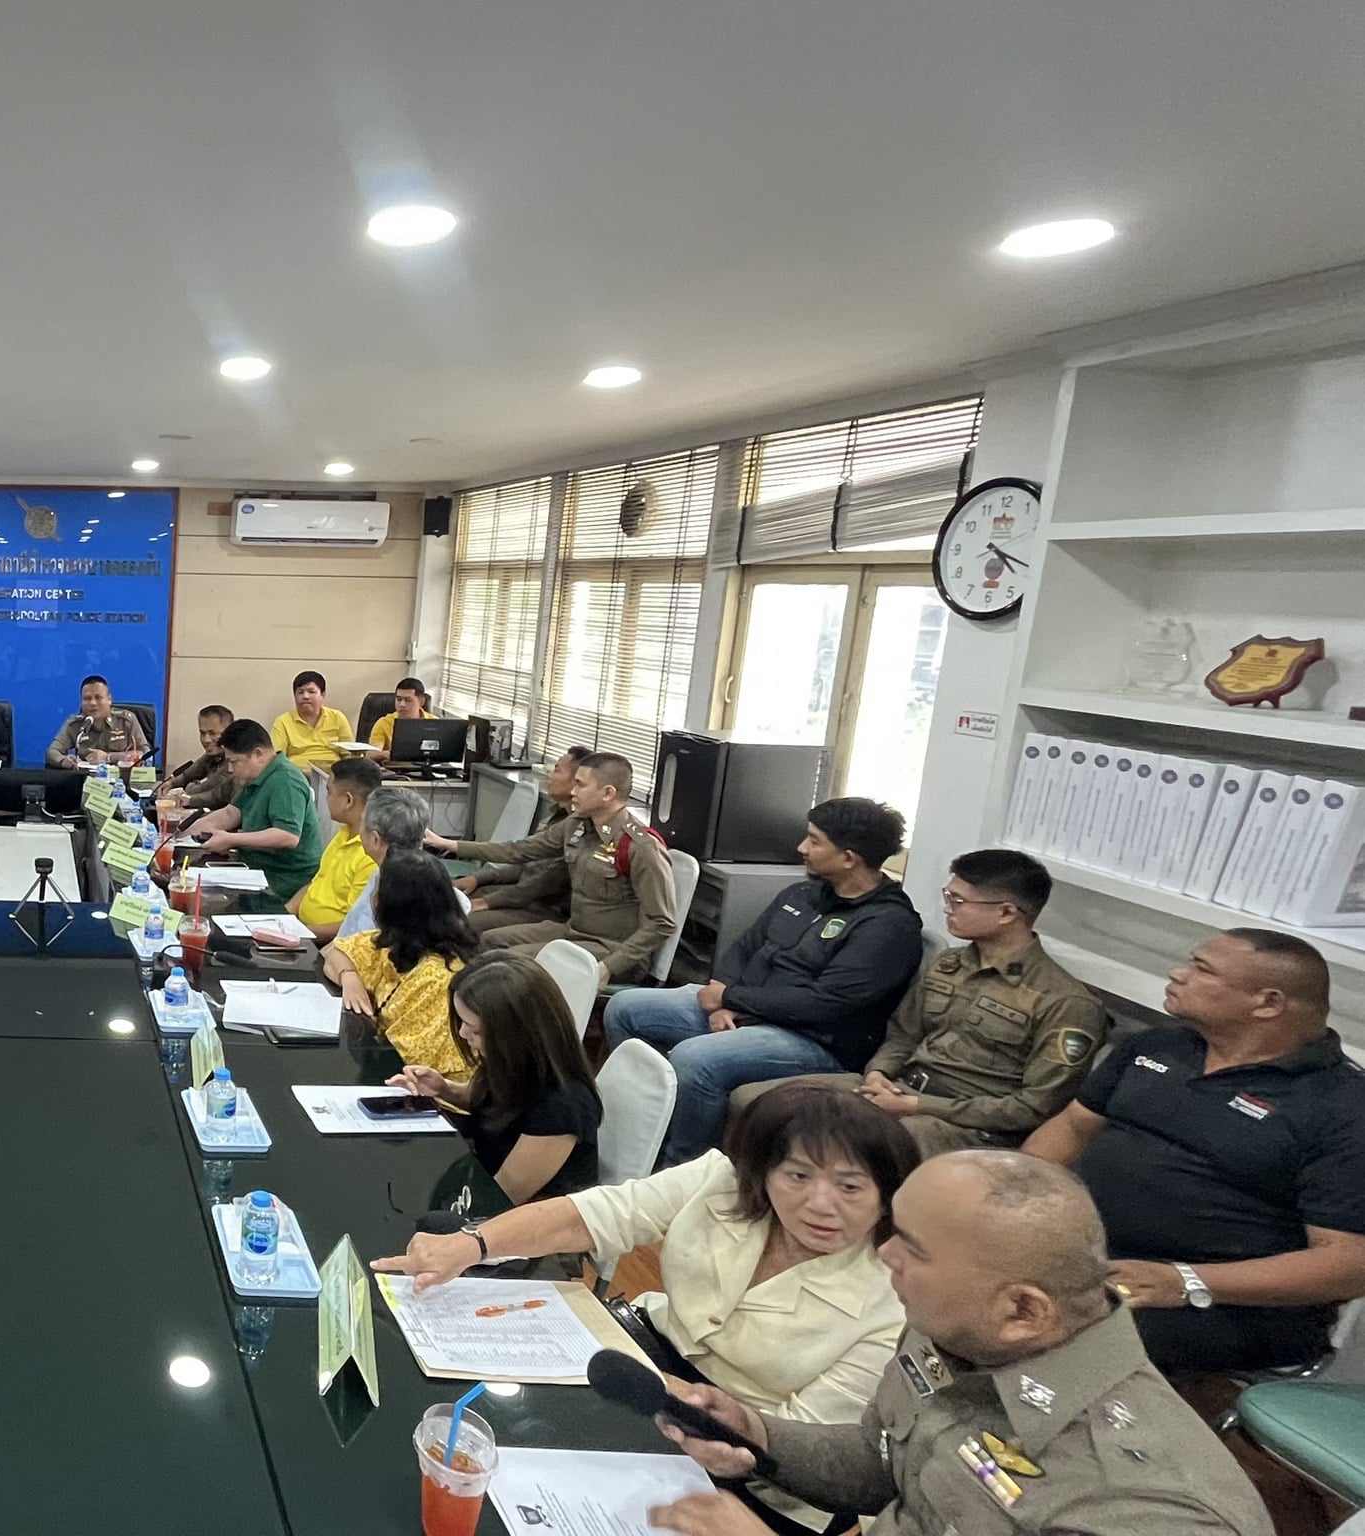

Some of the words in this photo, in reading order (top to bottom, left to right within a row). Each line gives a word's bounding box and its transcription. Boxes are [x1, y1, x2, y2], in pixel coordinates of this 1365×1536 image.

[1001, 495, 1013, 508] 12
[982, 504, 992, 516] 11
[965, 521, 976, 533] 10
[954, 544, 962, 556] 9
[955, 566, 963, 579] 8
[45, 588, 84, 601] CENTER
[966, 584, 975, 596] 7
[1006, 586, 1015, 598] 5
[984, 591, 992, 603] 6
[67, 611, 101, 623] POLICE
[105, 612, 147, 624] STATION
